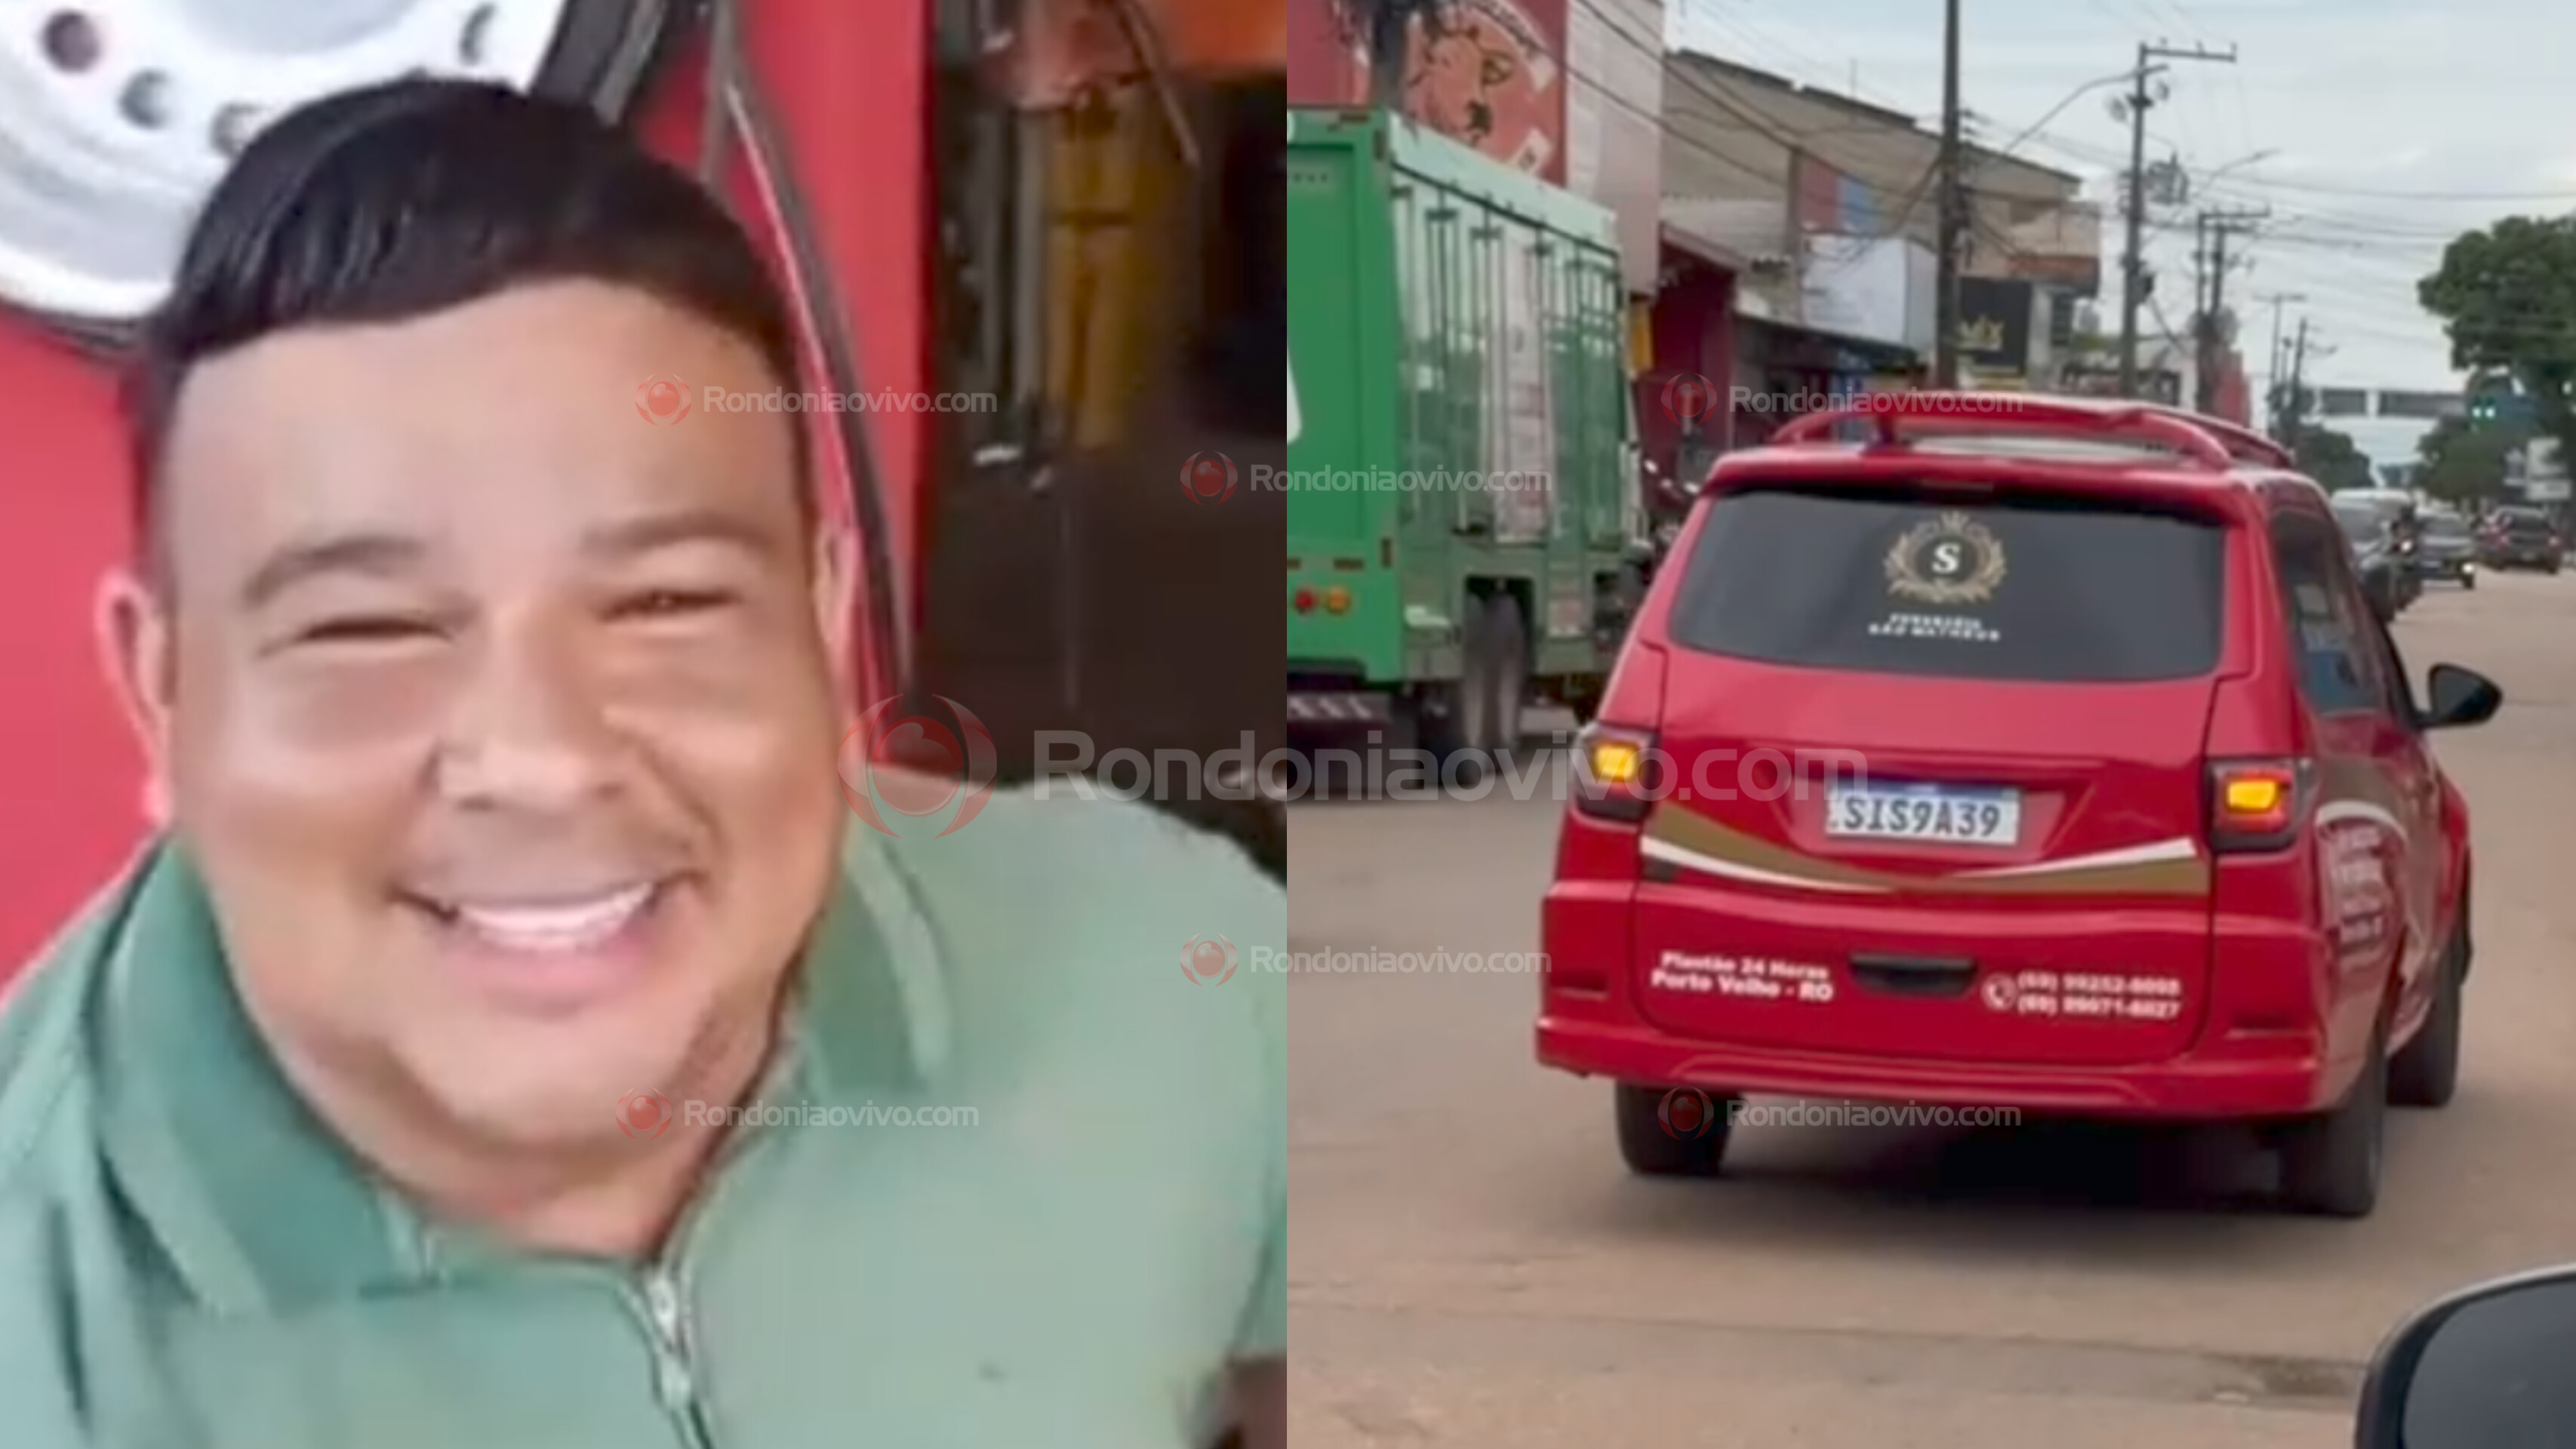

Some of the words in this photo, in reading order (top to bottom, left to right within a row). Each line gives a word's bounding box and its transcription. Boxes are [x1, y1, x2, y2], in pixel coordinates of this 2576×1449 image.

[1931, 542, 1961, 574] S
[1844, 795, 2000, 837] SIS9A39
[1651, 968, 1713, 992] Porto
[1718, 974, 1780, 998] Velho
[1799, 981, 1834, 1002] RO
[1741, 957, 1765, 976] 24
[1770, 960, 1830, 980] Horas
